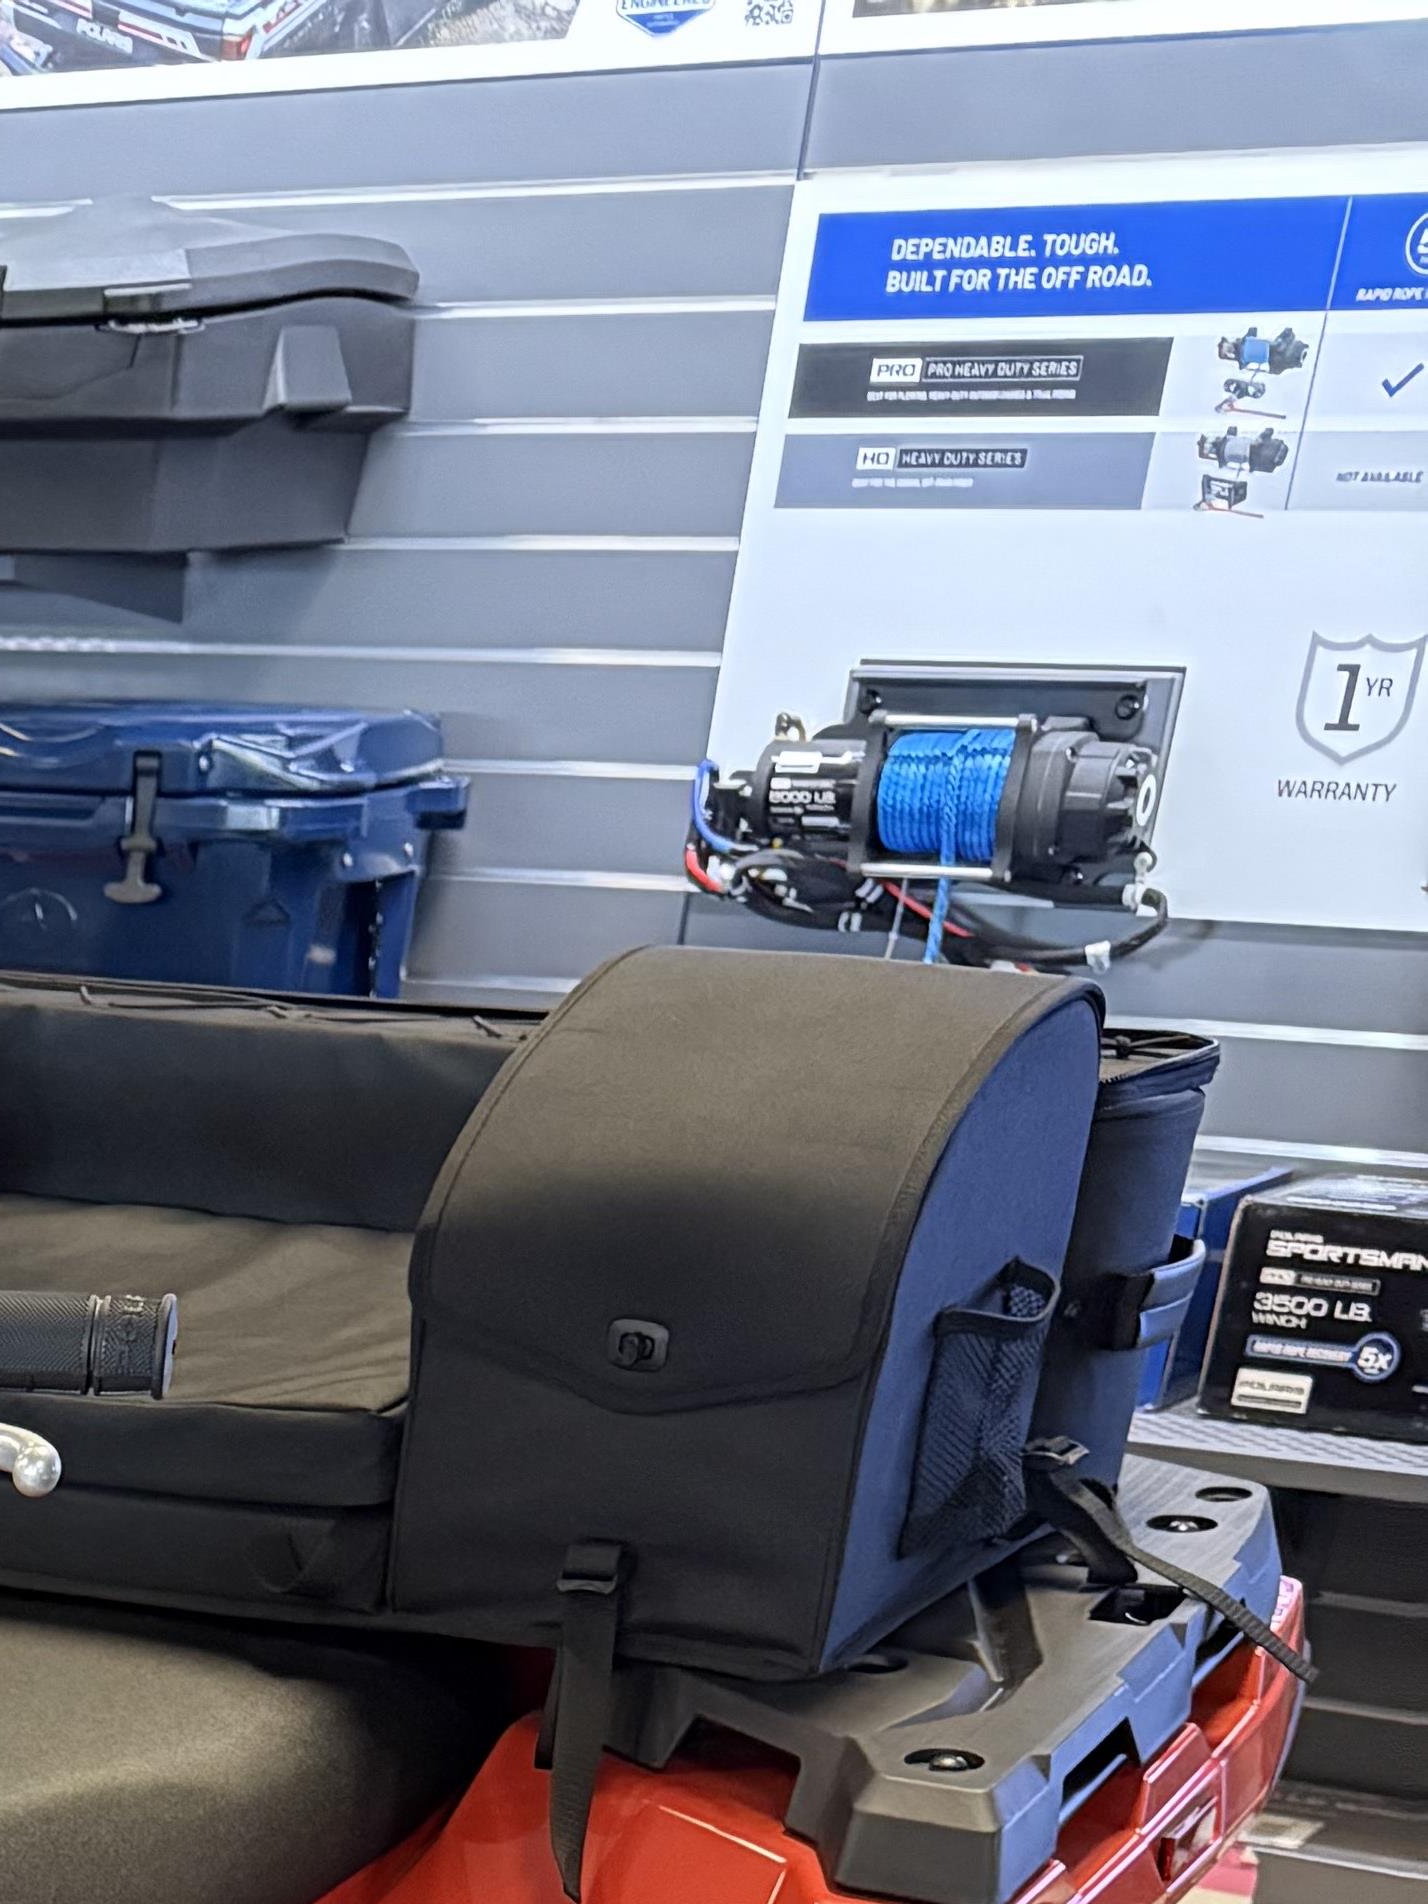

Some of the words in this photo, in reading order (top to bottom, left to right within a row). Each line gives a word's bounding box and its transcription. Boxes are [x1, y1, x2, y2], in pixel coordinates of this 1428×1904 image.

[891, 234, 1036, 261] DEPENDABLE.
[1043, 232, 1119, 256] TOUGH.
[885, 268, 945, 294] BUILT
[949, 267, 991, 292] FOR
[996, 266, 1037, 291] THE
[1041, 265, 1084, 289] OFF
[1087, 264, 1153, 288] ROAD.
[876, 364, 916, 377] PRO
[927, 363, 952, 377] PRO
[954, 362, 996, 377] HEAVY
[997, 362, 1030, 376] DUTY
[1032, 361, 1078, 376] SERIES
[1323, 664, 1361, 731] 1
[1366, 677, 1394, 697] YR
[1277, 779, 1397, 802] WARRANTY
[1253, 1292, 1328, 1317] 3500
[1251, 1311, 1307, 1329] WINCH
